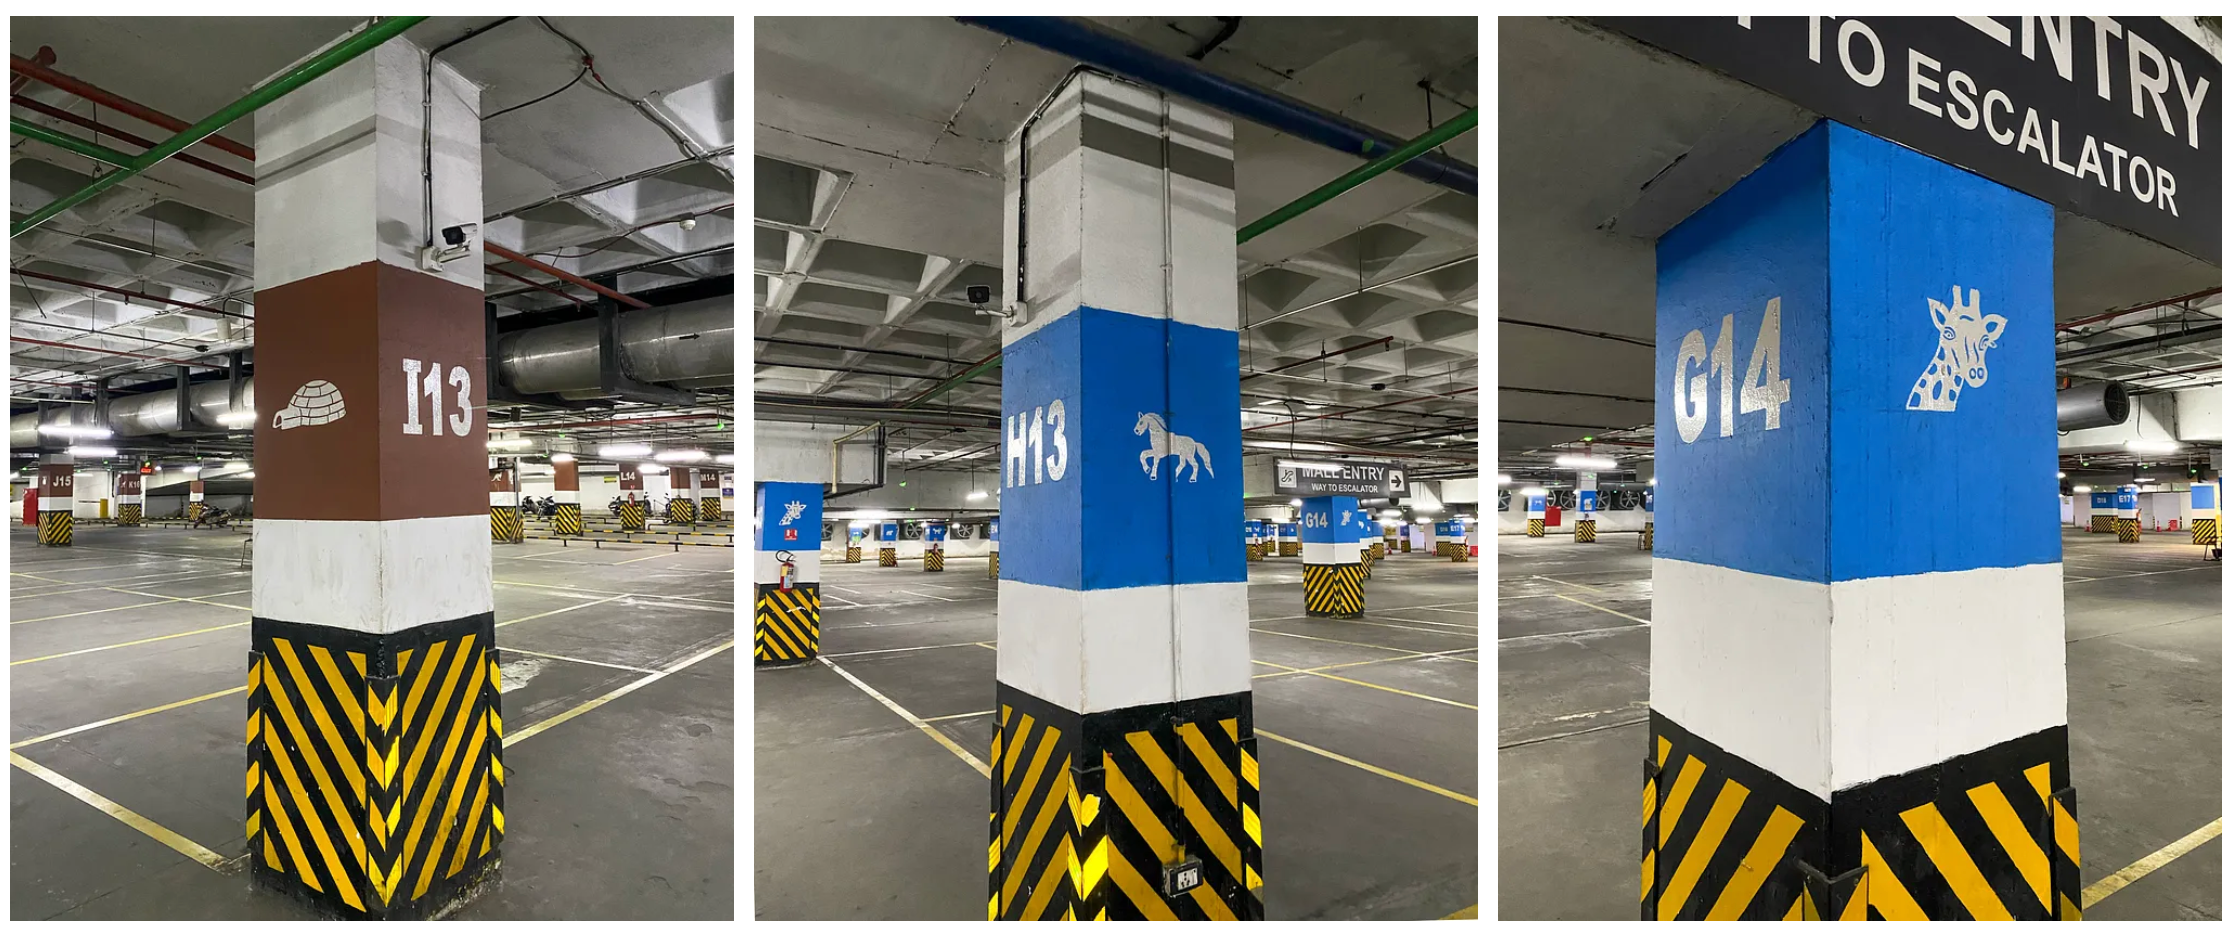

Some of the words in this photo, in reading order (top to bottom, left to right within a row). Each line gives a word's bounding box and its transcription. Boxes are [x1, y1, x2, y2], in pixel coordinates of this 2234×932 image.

[1954, 16, 2210, 150] NTRY
[1809, 16, 1885, 87] TO
[1908, 47, 2179, 217] ESCALATOR
[1674, 296, 1791, 444] G14
[403, 358, 472, 437] I13
[1007, 399, 1068, 488] H13
[53, 476, 72, 487] J15
[621, 472, 636, 481] L14
[1302, 466, 1340, 478] MALL
[1343, 465, 1384, 480] ENTRY
[1311, 483, 1327, 492] WAY
[1328, 483, 1338, 492] TO
[1339, 484, 1379, 493] ESCALATOR
[1305, 512, 1329, 528] G14
